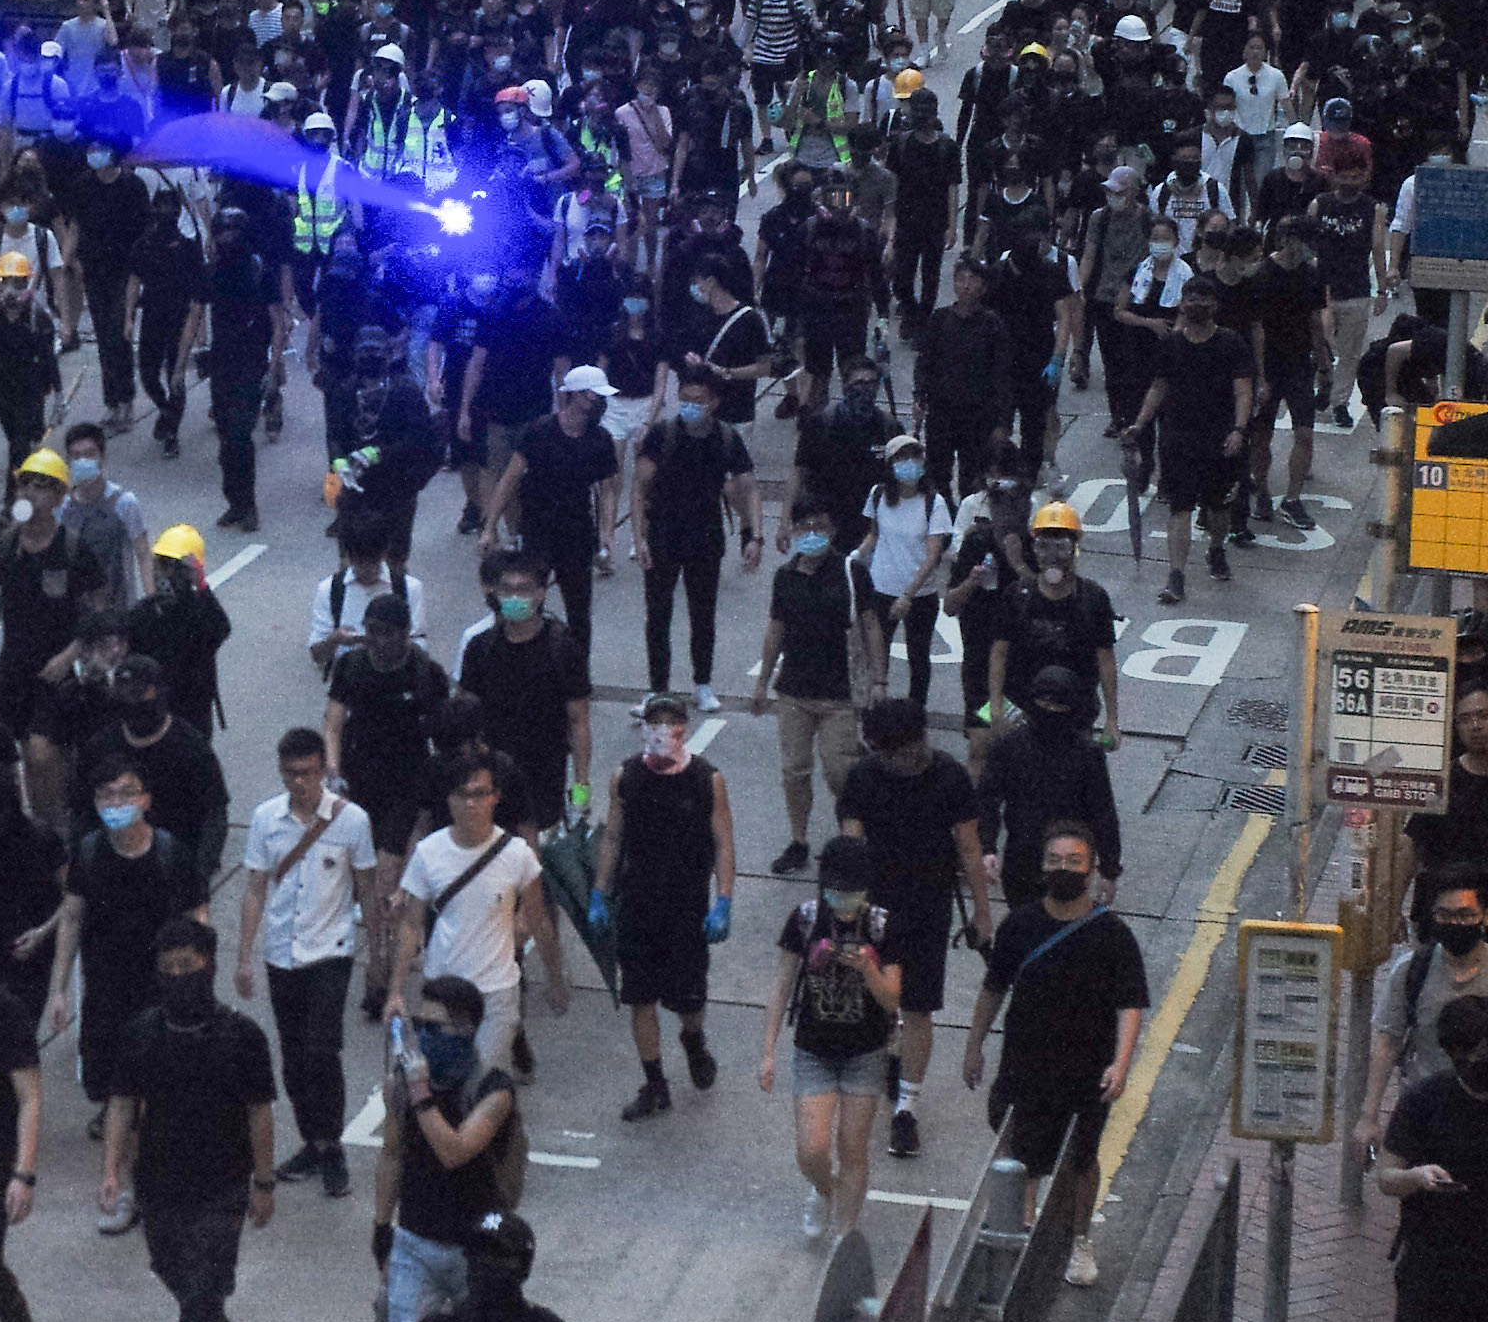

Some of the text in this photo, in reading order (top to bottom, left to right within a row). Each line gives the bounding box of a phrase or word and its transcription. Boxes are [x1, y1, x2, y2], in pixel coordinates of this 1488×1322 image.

[1419, 465, 1443, 486] 10
[1341, 619, 1395, 636] AMS
[1338, 667, 1371, 690] 56
[1336, 692, 1368, 714] 56A
